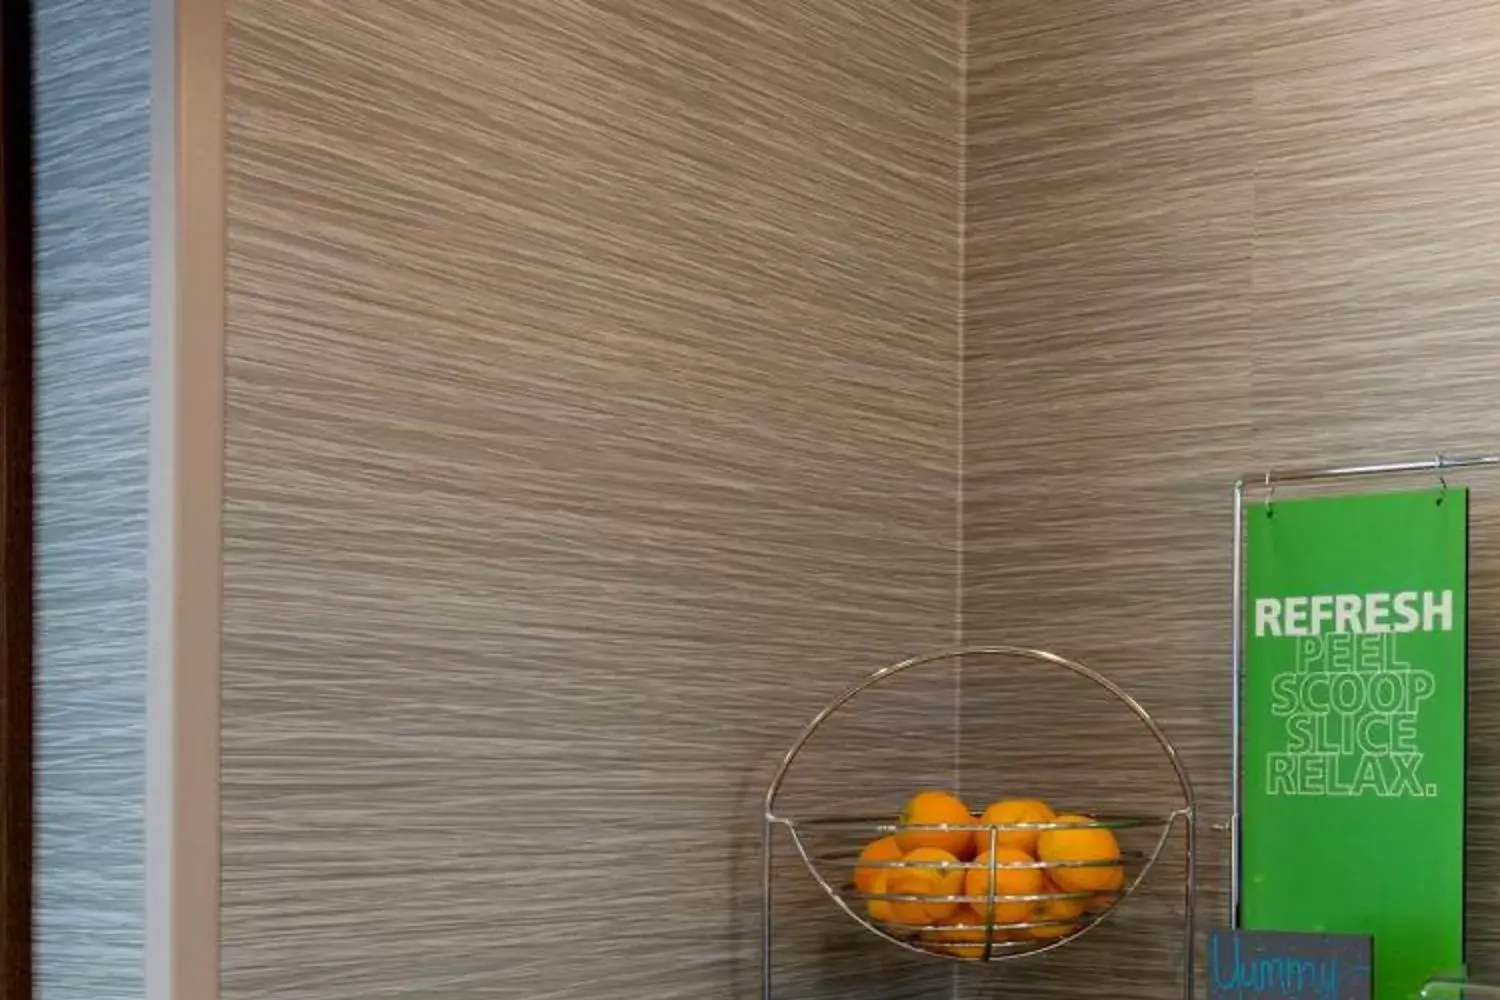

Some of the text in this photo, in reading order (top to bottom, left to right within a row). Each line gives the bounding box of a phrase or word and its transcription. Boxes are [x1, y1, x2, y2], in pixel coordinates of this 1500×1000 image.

[1254, 590, 1453, 637] REFRESH
[1296, 630, 1410, 674] PEEL
[1271, 669, 1435, 716] SCOOP
[1286, 711, 1417, 754] SLICE
[1266, 752, 1437, 797] RELAX.
